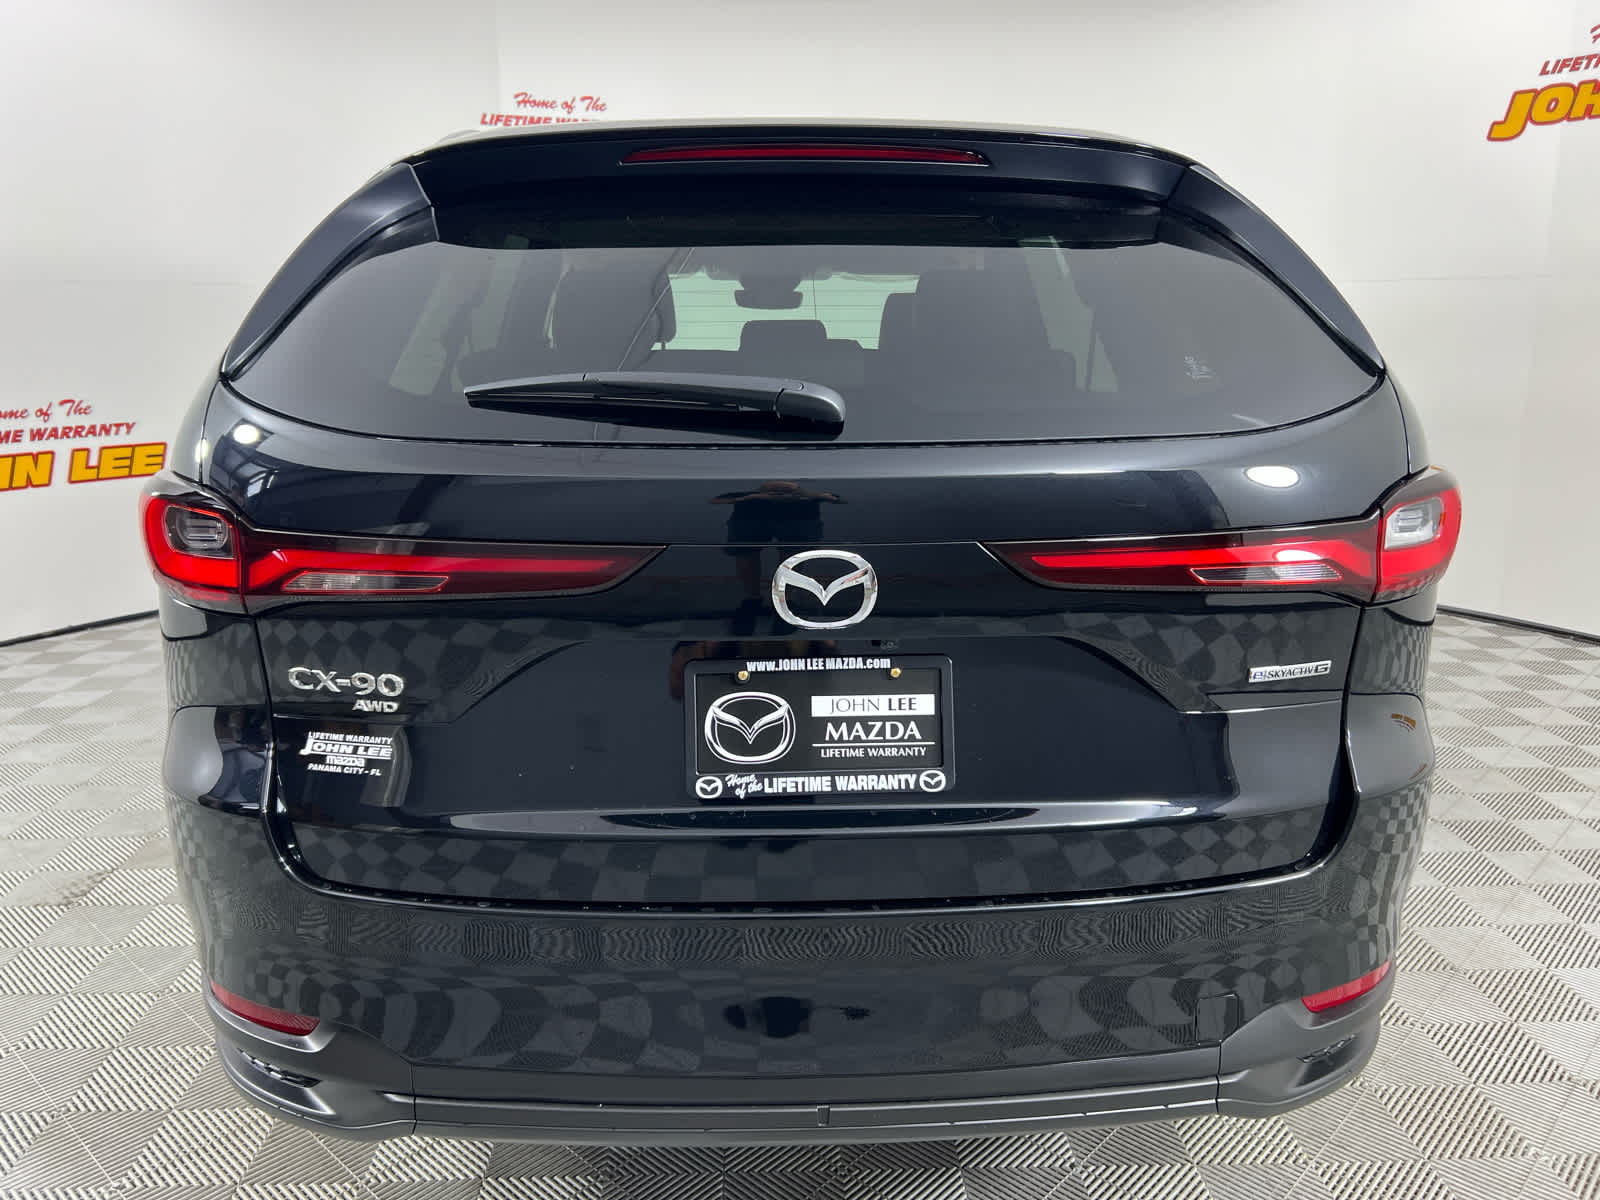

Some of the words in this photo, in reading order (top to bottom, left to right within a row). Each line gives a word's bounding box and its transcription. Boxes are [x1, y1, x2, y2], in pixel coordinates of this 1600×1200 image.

[513, 91, 557, 109] Home
[561, 96, 576, 114] of
[580, 96, 607, 112] The
[480, 113, 552, 126] LIFETIME
[35, 402, 52, 423] of
[59, 398, 92, 417] The
[29, 421, 136, 442] WARRANTY
[68, 441, 167, 484] LEE
[287, 666, 405, 697] CX-90
[351, 699, 399, 713] AWD
[829, 698, 880, 714] JOHN
[887, 697, 917, 712] LEE
[308, 731, 344, 742] LIFETIME
[345, 734, 393, 746] WARRANTY
[825, 720, 922, 741] MAZDA
[299, 738, 354, 756] JOHN
[356, 746, 393, 758] LEE
[820, 747, 865, 758] LIFETIME
[867, 746, 927, 757] WARRANTY
[307, 763, 342, 773] PANAMA
[343, 767, 364, 775] CITY
[370, 768, 383, 776] FL
[725, 773, 756, 787] Home
[735, 783, 747, 799] of
[747, 779, 763, 793] the
[763, 775, 832, 793] LIFETIME
[834, 773, 917, 792] WARRANTY
